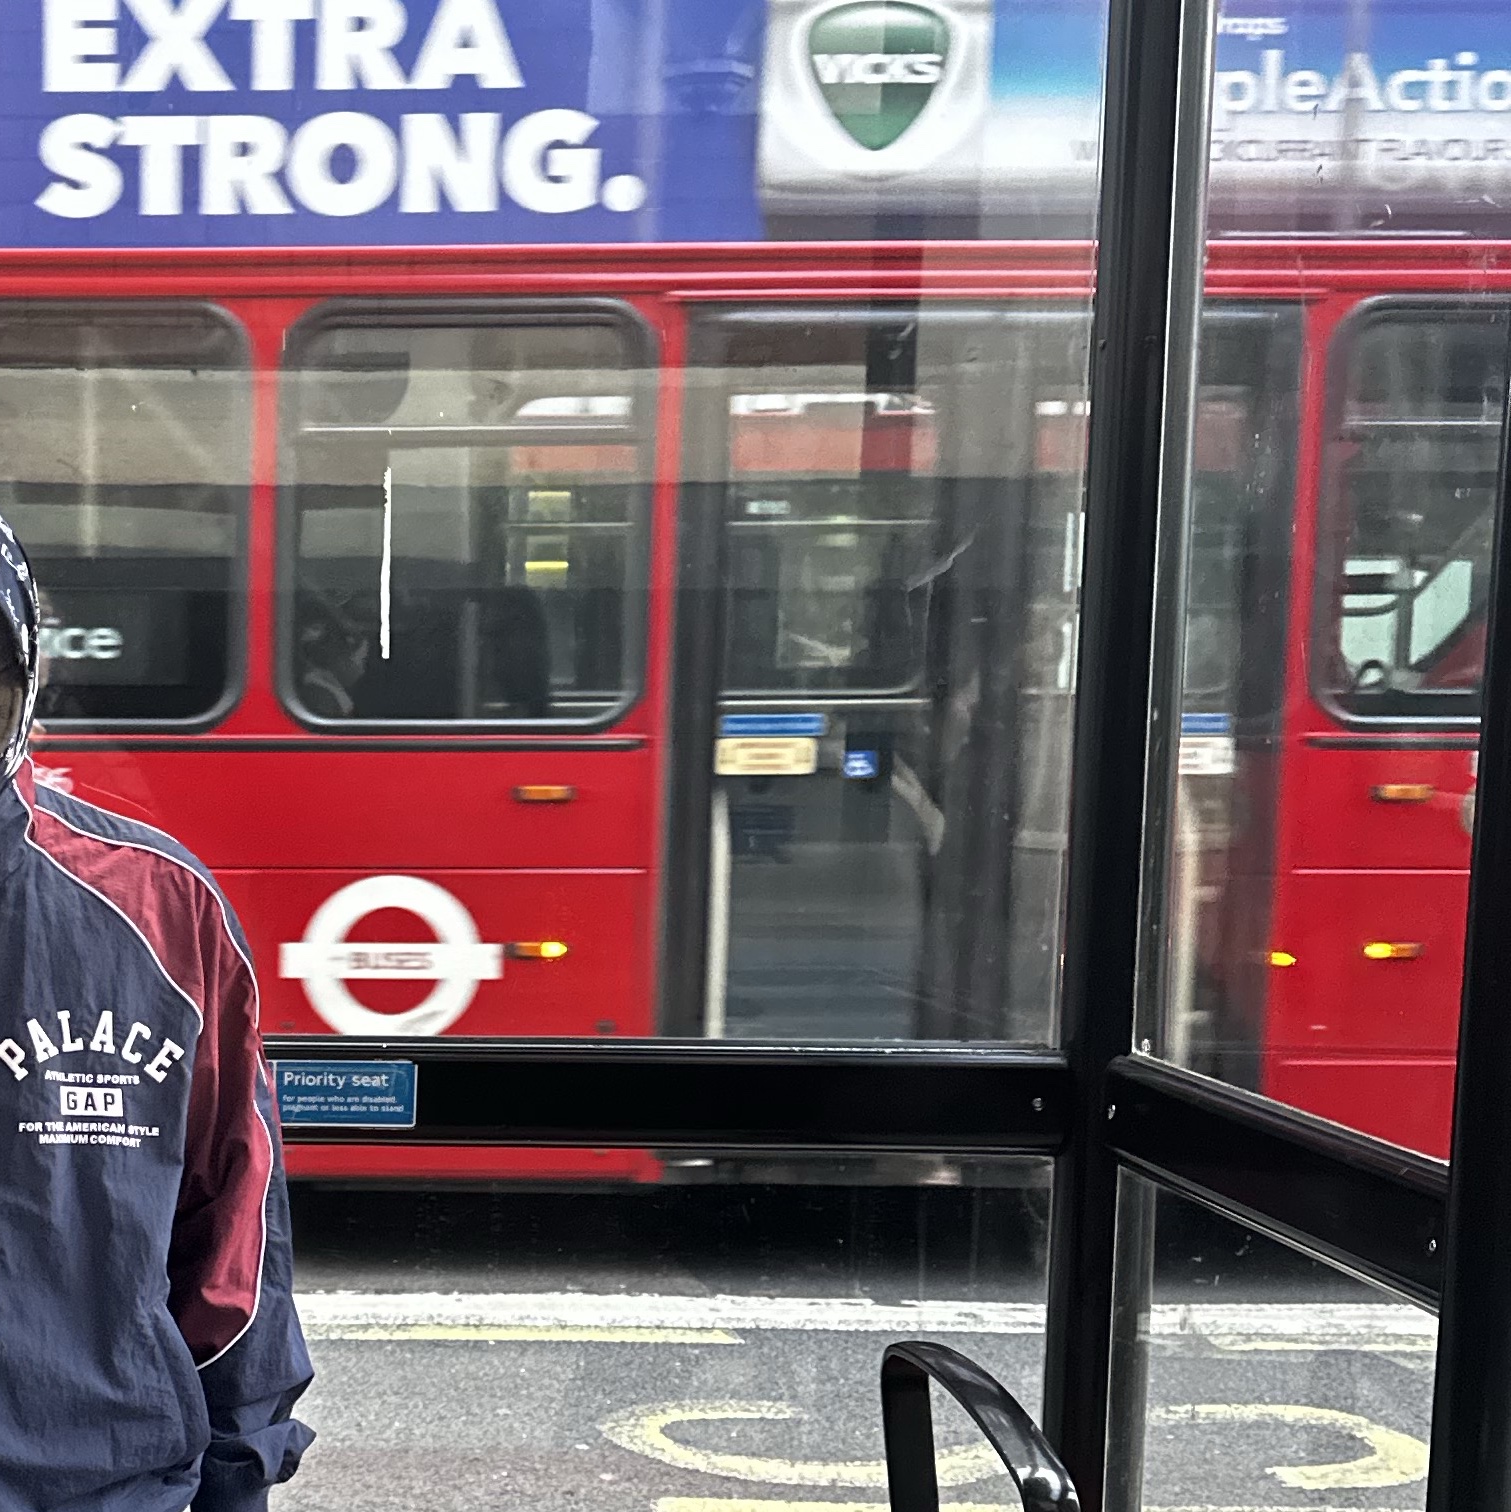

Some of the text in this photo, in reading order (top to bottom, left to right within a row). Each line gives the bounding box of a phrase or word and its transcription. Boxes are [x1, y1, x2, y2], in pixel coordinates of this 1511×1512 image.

[41, 0, 526, 93] EXTRA
[812, 53, 944, 84] VICKS
[1215, 49, 1511, 112] pleActio
[33, 108, 648, 218] STRONG.
[44, 1070, 141, 1085] ATHLETIC SPORTS
[284, 1071, 390, 1090] Priority seat
[66, 1091, 116, 1112] GAP
[18, 1122, 160, 1137] FOR THE AMERICAN STYLE
[89, 1136, 142, 1148] COMFORT
